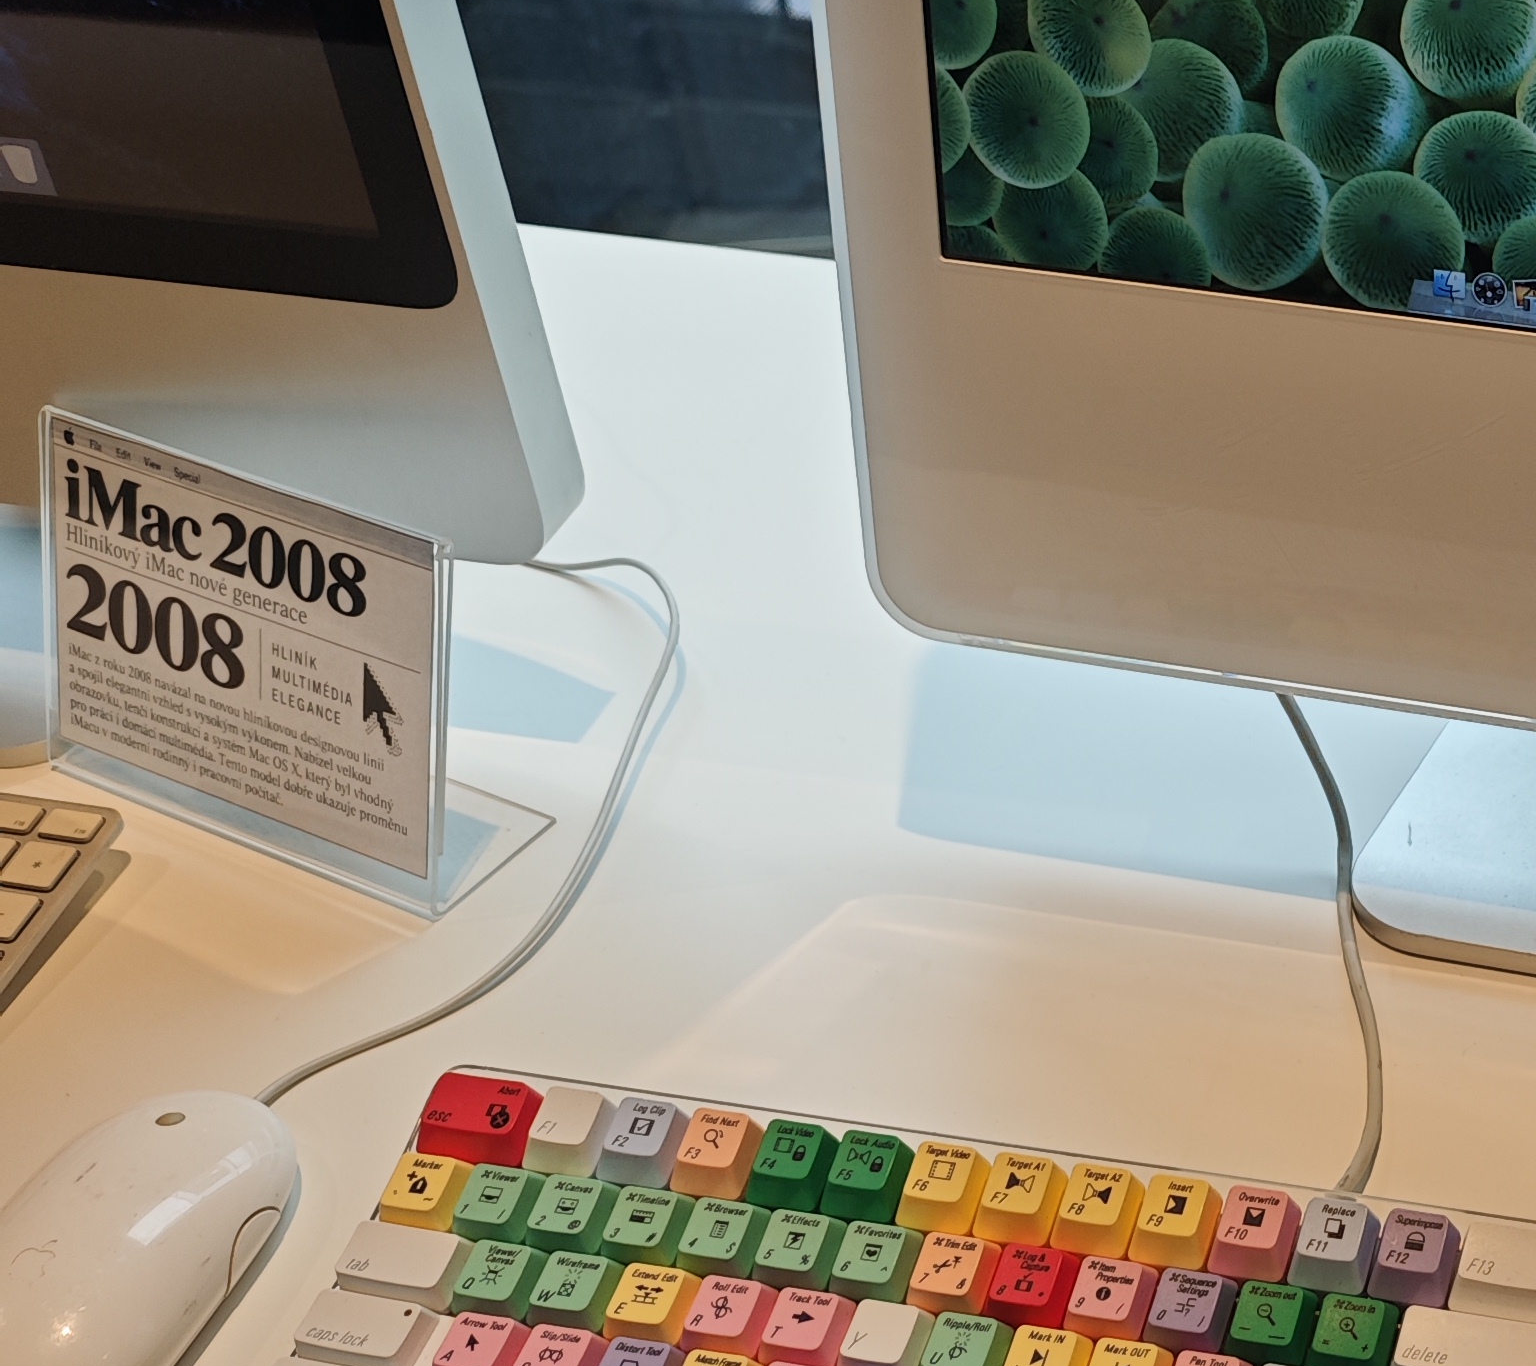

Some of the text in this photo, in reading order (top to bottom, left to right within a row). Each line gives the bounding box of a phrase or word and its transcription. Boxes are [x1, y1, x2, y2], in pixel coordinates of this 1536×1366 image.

[64, 458, 367, 618] iMac 2008
[66, 522, 308, 625] Hliníkový iMac nové generace
[66, 563, 246, 690] 2008
[271, 642, 318, 671] HLINÍK
[271, 665, 353, 707] MULTIMÉDIA
[271, 687, 341, 726] ELEGANCE
[427, 1109, 452, 1123] esc
[537, 1120, 559, 1135] F1
[835, 1168, 854, 1181] F5
[911, 1178, 930, 1192] F6
[989, 1191, 1009, 1204] F7
[1067, 1202, 1086, 1216] F8
[1146, 1215, 1163, 1227] F9
[1223, 1226, 1249, 1241] F10
[1305, 1238, 1329, 1252] F11
[1386, 1250, 1410, 1264] F12
[345, 1258, 370, 1272] tab
[1466, 1258, 1494, 1275] F13
[305, 1326, 368, 1348] caps lock
[1402, 1344, 1448, 1365] delete
